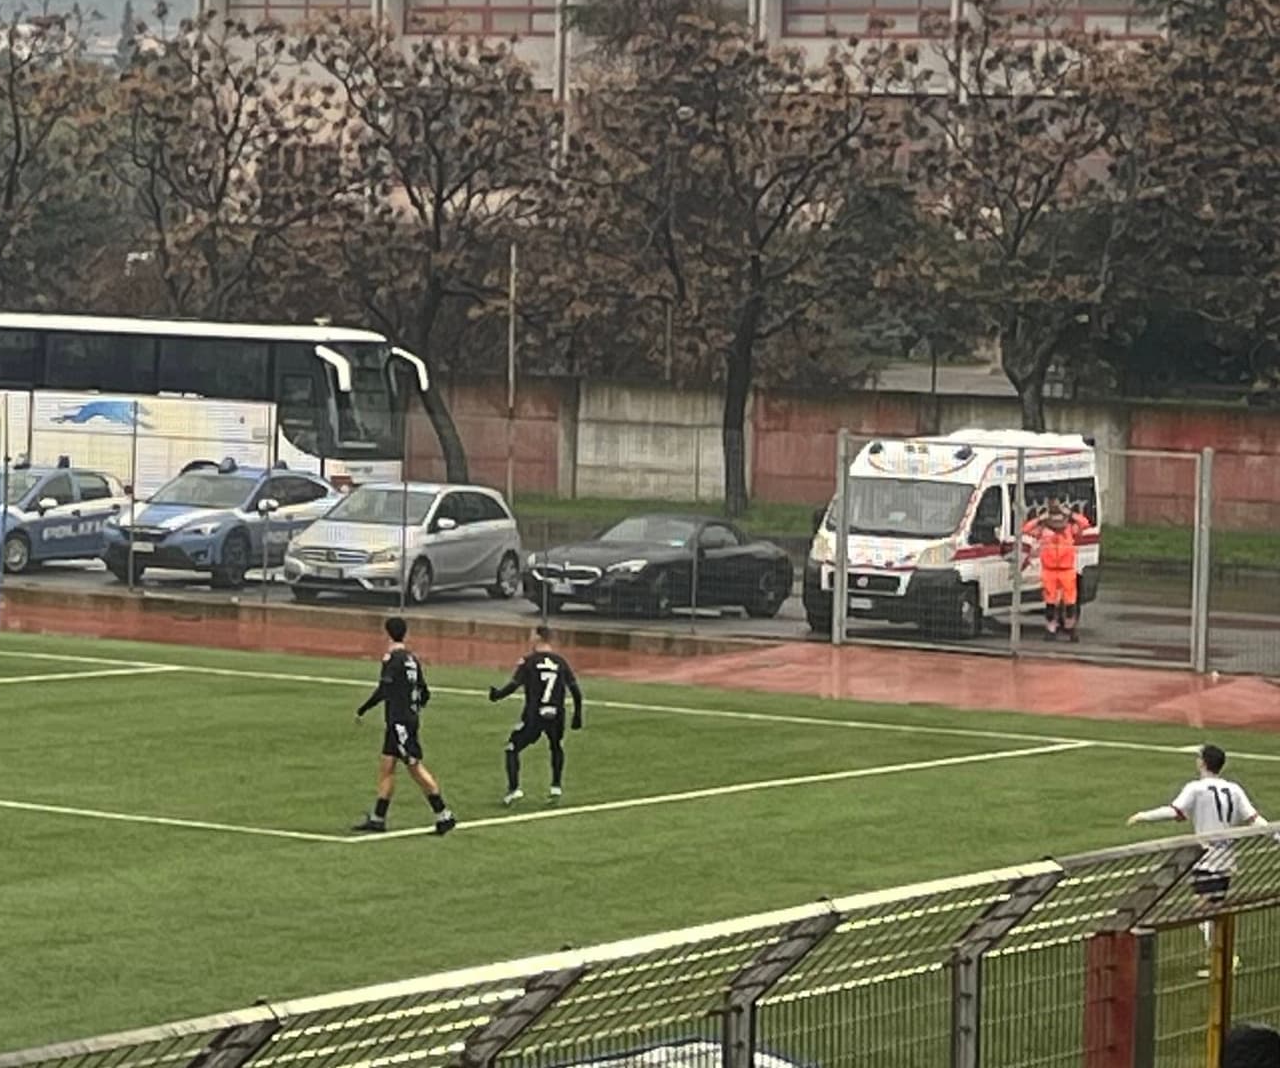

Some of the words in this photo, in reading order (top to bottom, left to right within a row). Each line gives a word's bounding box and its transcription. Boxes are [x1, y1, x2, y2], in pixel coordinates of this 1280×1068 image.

[43, 520, 106, 540] POLIZI
[540, 672, 557, 703] 7
[1208, 785, 1233, 823] 11
